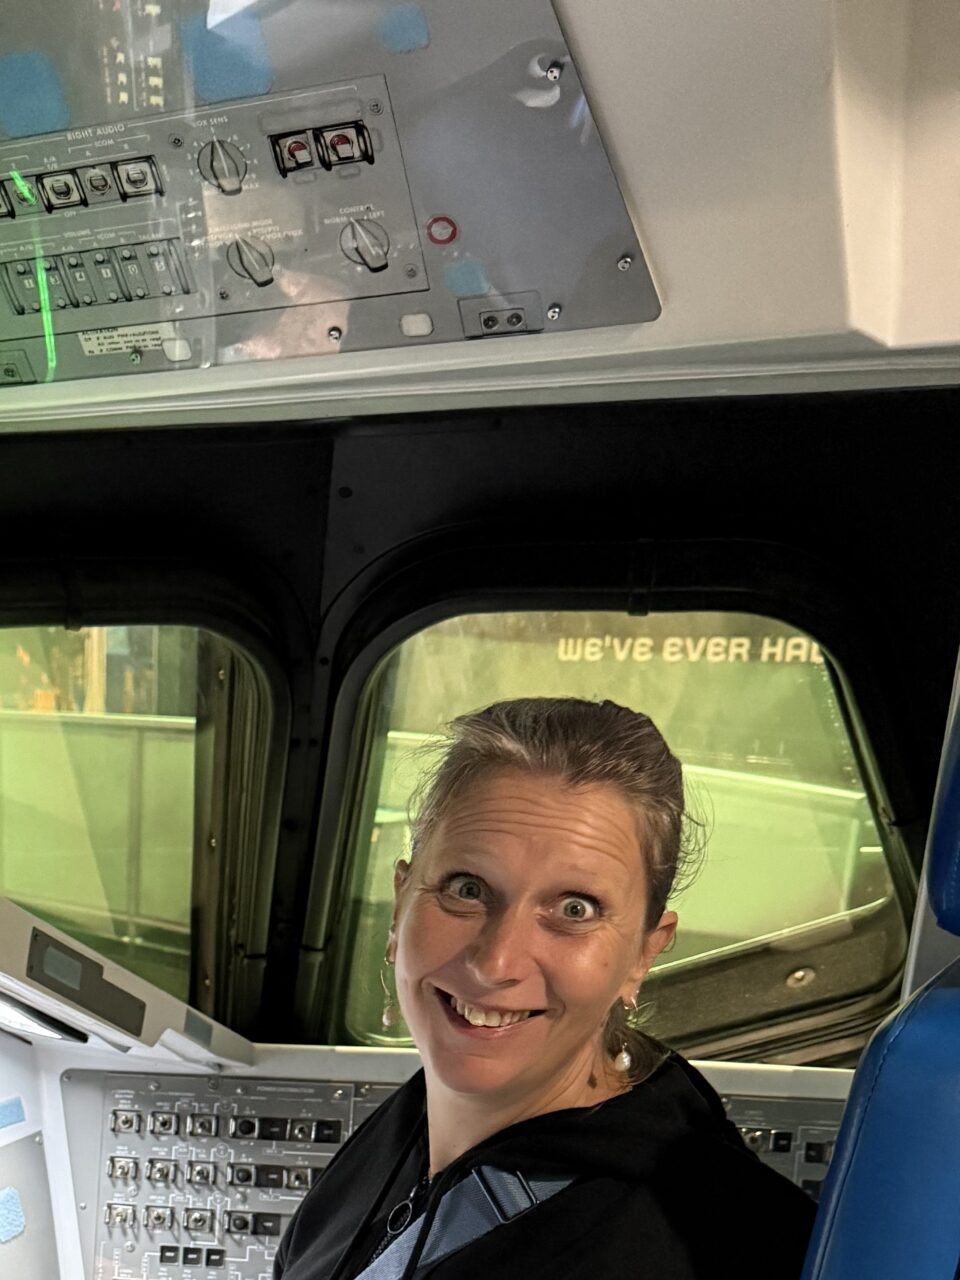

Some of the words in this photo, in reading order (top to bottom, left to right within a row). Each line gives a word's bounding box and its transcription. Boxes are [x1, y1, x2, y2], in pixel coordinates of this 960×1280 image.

[210, 116, 228, 125] SENS
[66, 128, 93, 141] RIGHT
[96, 124, 125, 137] AUDIO
[339, 203, 375, 214] CONTROL
[557, 634, 655, 663] WE'VE
[661, 636, 751, 663] EVER
